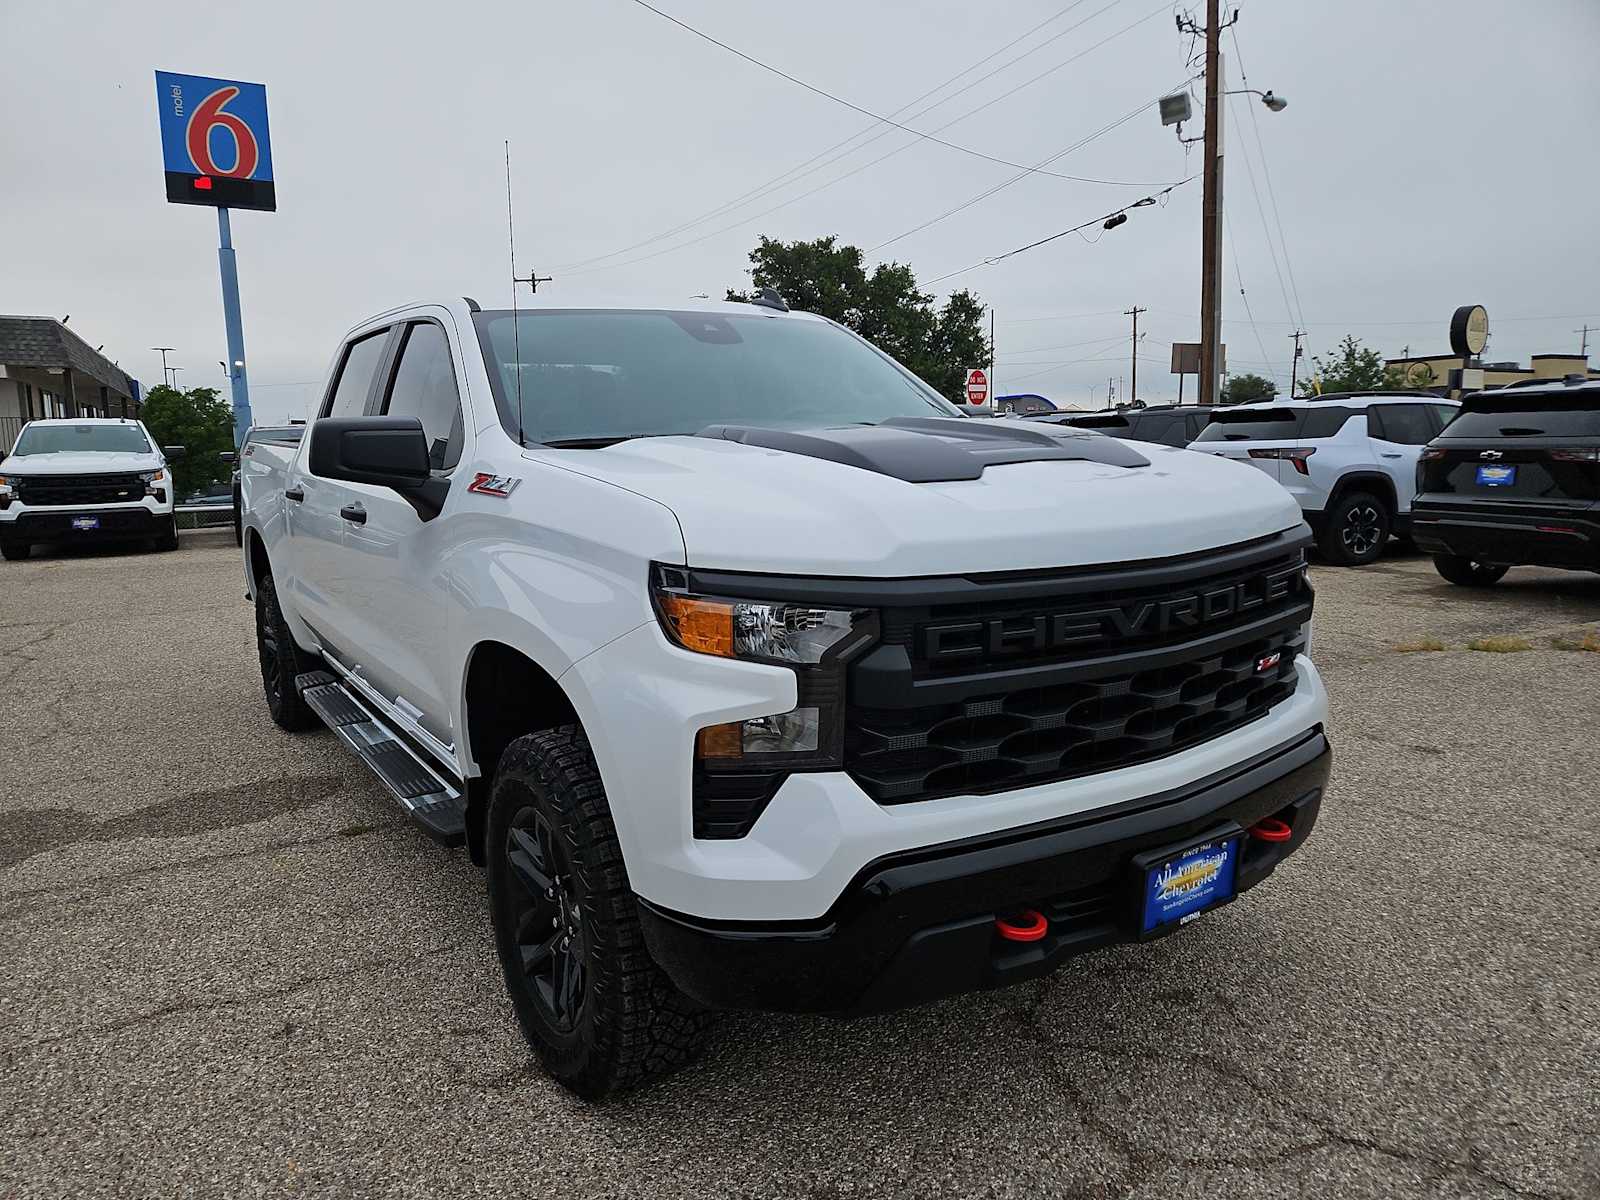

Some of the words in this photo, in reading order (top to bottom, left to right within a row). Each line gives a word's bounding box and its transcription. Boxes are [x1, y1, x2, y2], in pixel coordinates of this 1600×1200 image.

[170, 85, 184, 117] motel
[185, 86, 259, 179] 6
[969, 376, 976, 384] DO
[976, 376, 985, 384] NOT
[970, 392, 984, 400] ENTER
[467, 472, 522, 499] Z71
[1154, 868, 1172, 888] All
[1178, 851, 1228, 876] American
[1163, 869, 1217, 900] Chevrolet
